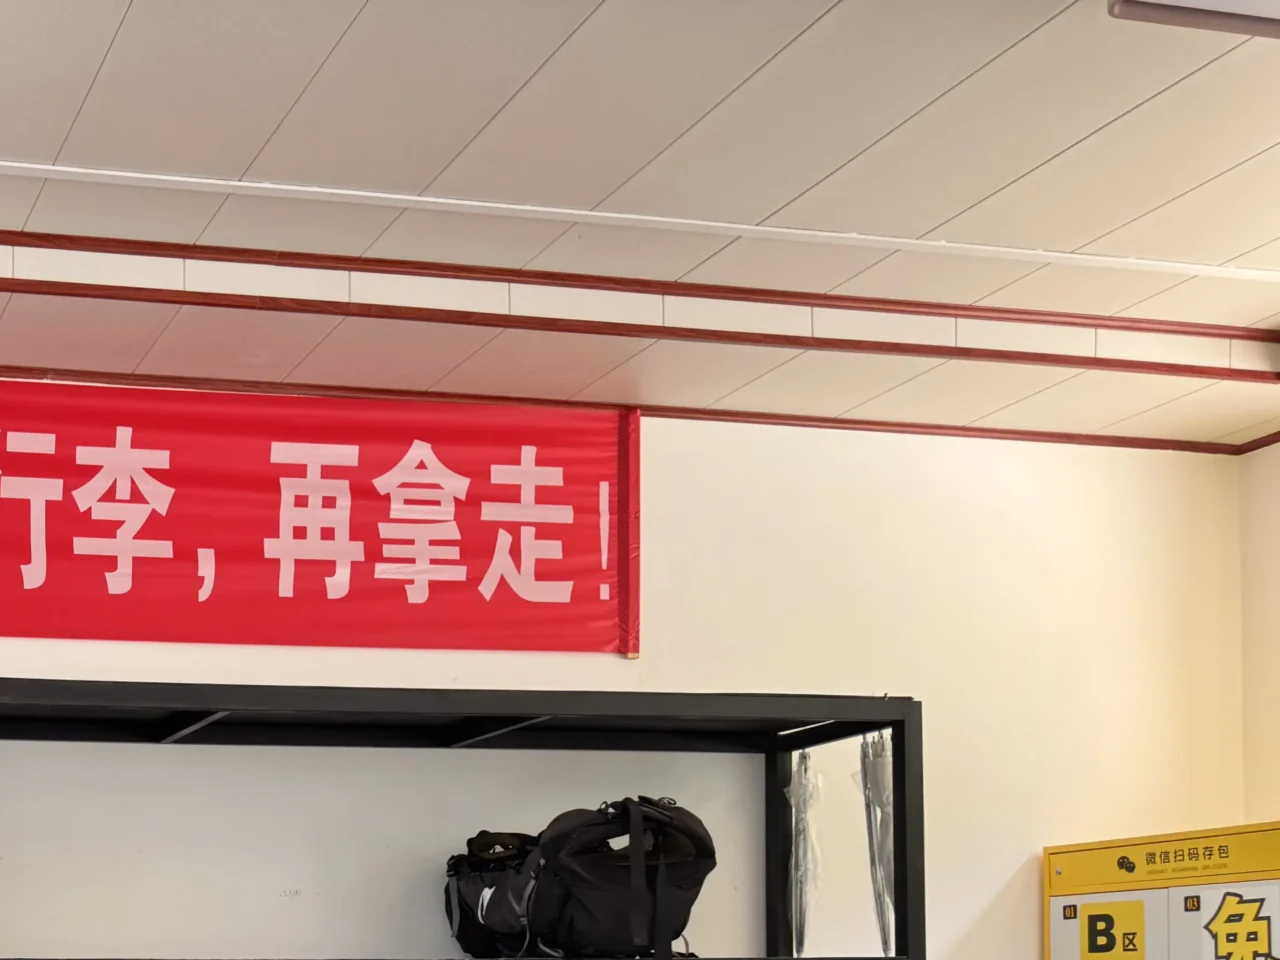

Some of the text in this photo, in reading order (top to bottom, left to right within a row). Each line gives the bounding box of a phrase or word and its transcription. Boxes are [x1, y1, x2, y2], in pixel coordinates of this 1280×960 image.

[1145, 844, 1230, 865] 微信扫码存包
[1186, 897, 1198, 910] 03
[1065, 905, 1075, 918] 01
